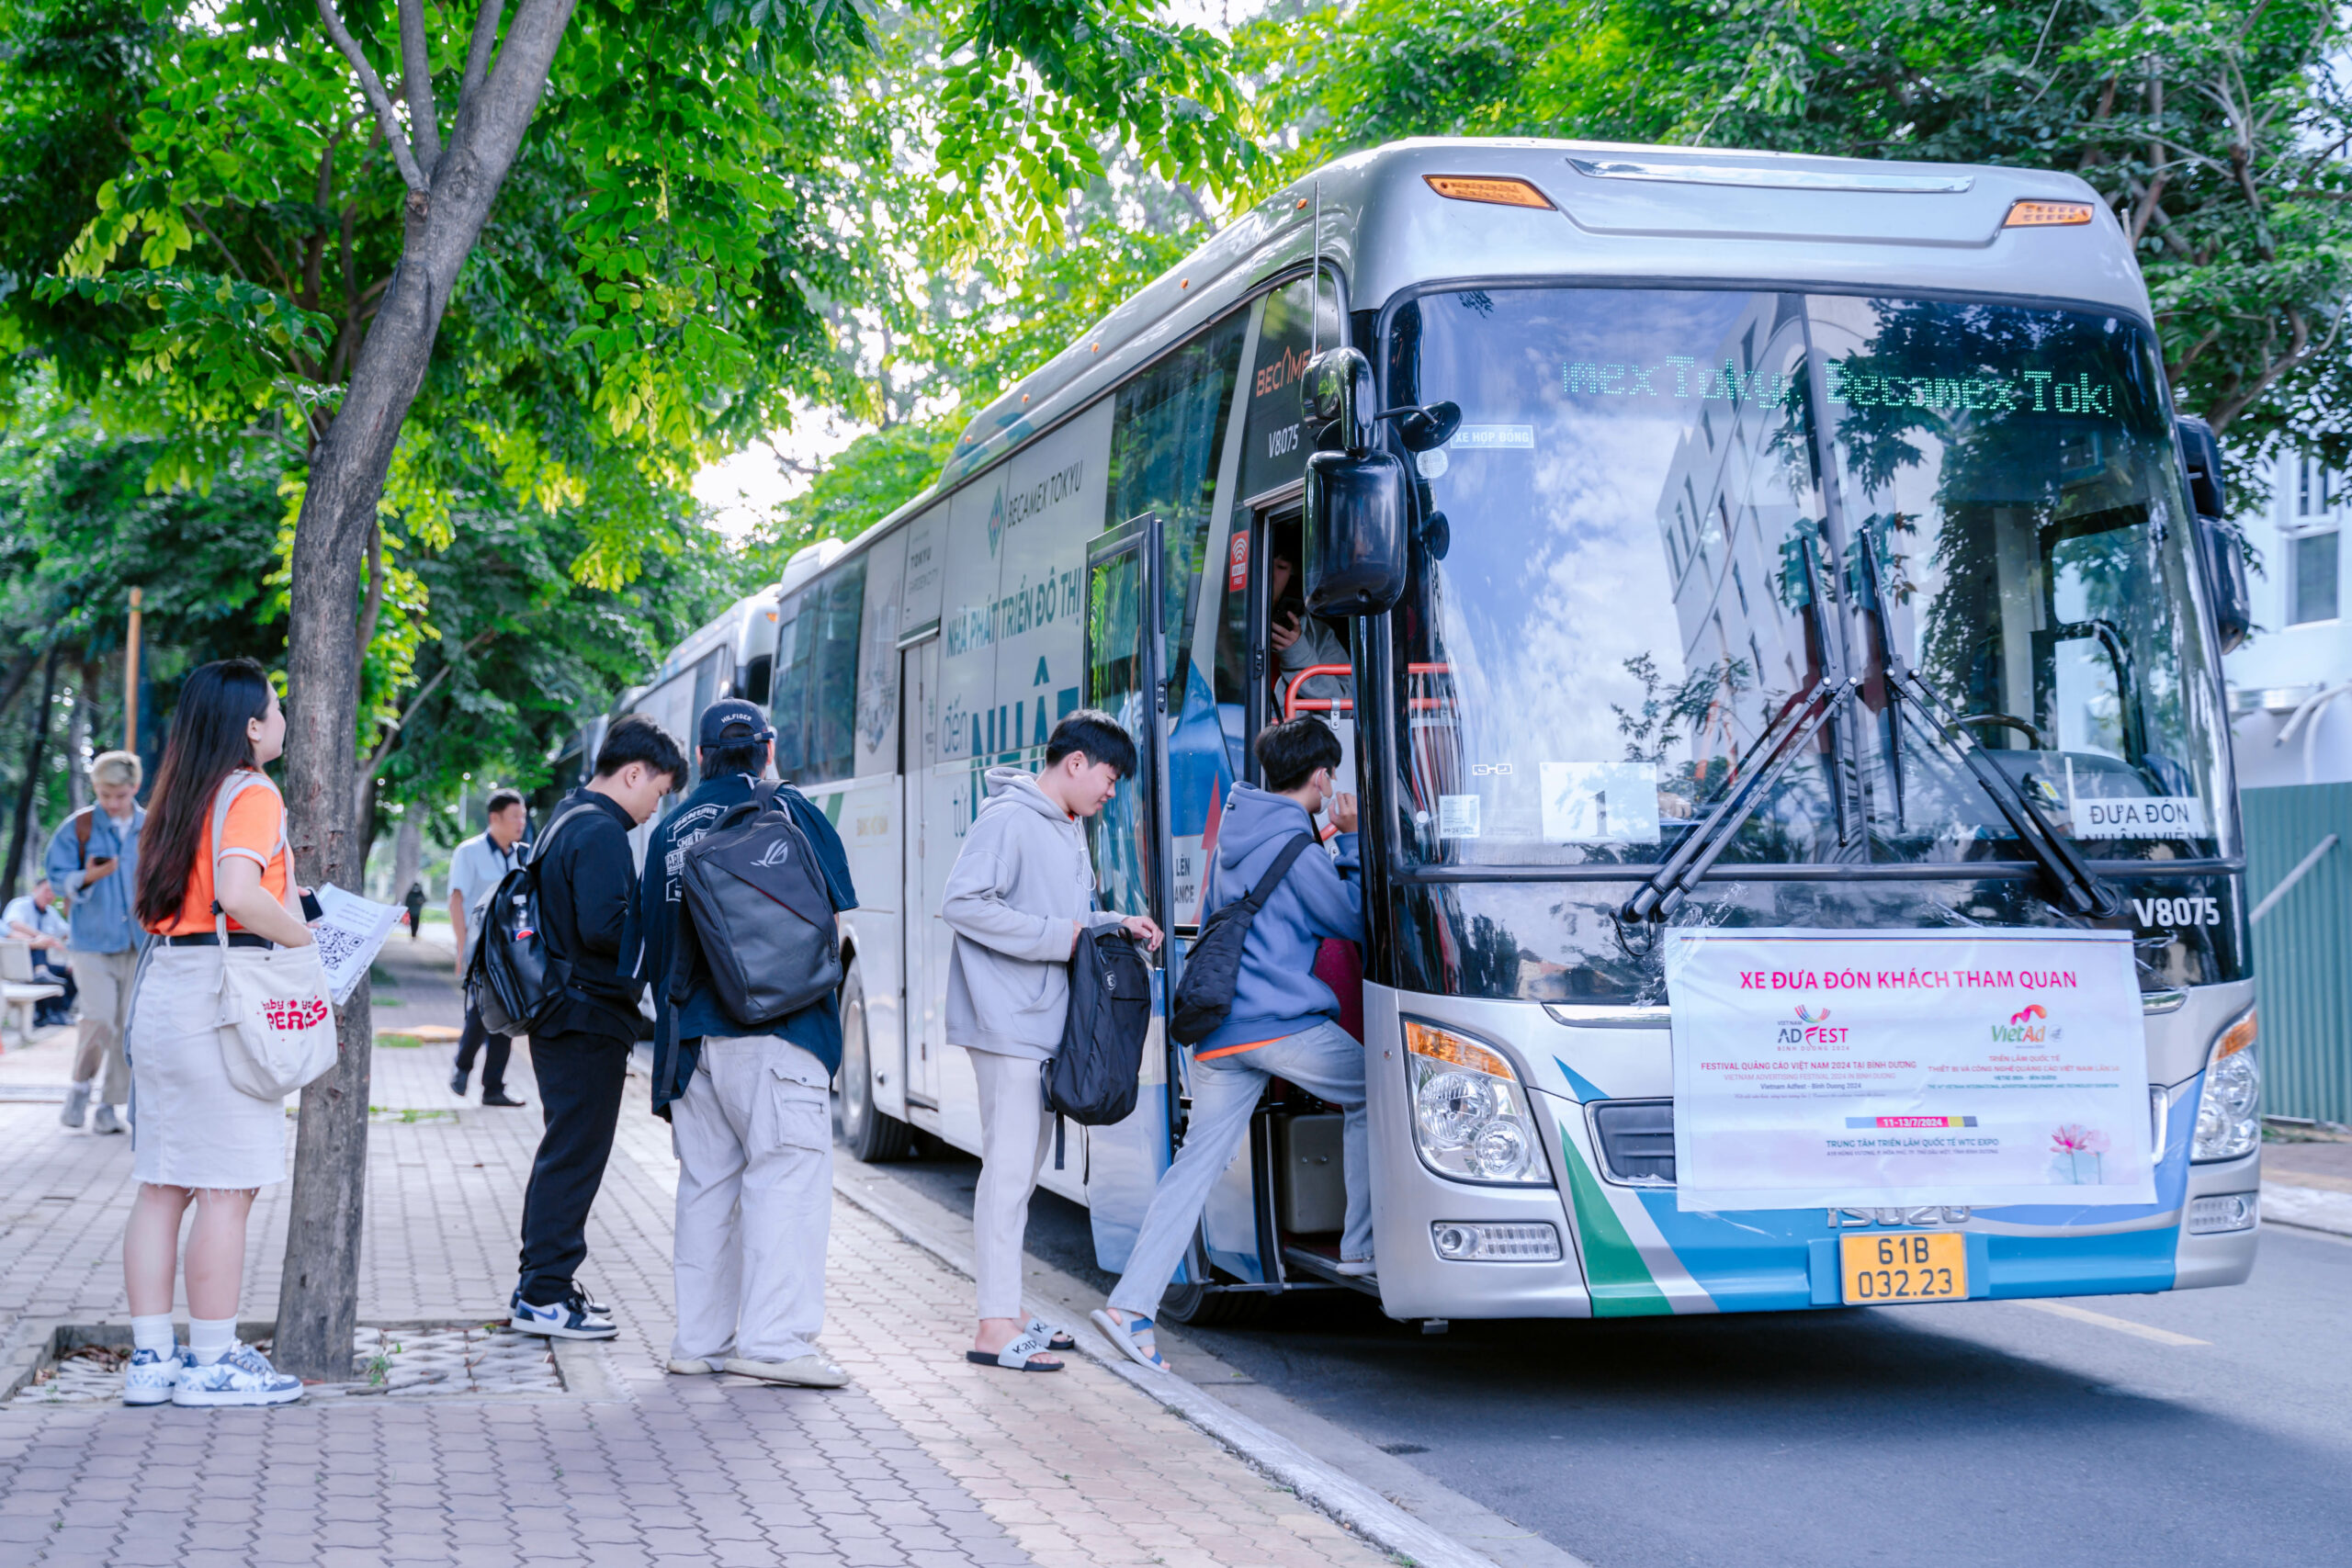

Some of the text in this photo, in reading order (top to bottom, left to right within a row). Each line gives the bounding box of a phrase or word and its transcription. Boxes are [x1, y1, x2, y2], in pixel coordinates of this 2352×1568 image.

[1268, 423, 1300, 458] V8075
[1455, 432, 1469, 443] XE
[1008, 459, 1083, 529] BECAMEX TOKYU
[969, 593, 999, 651] PHÁT
[1060, 566, 1082, 626] THỊ
[720, 713, 752, 724] HILFIGER
[2089, 798, 2189, 824] ĐƯA ĐÓN
[2132, 897, 2221, 928] V8075
[1739, 967, 2077, 989] XE ĐƯA ĐÓN KHÁCH THAM QUAN
[1701, 1062, 1739, 1070] FESTIVAL
[1878, 1236, 1929, 1265] 61B
[1858, 1268, 1952, 1298] 032.23
